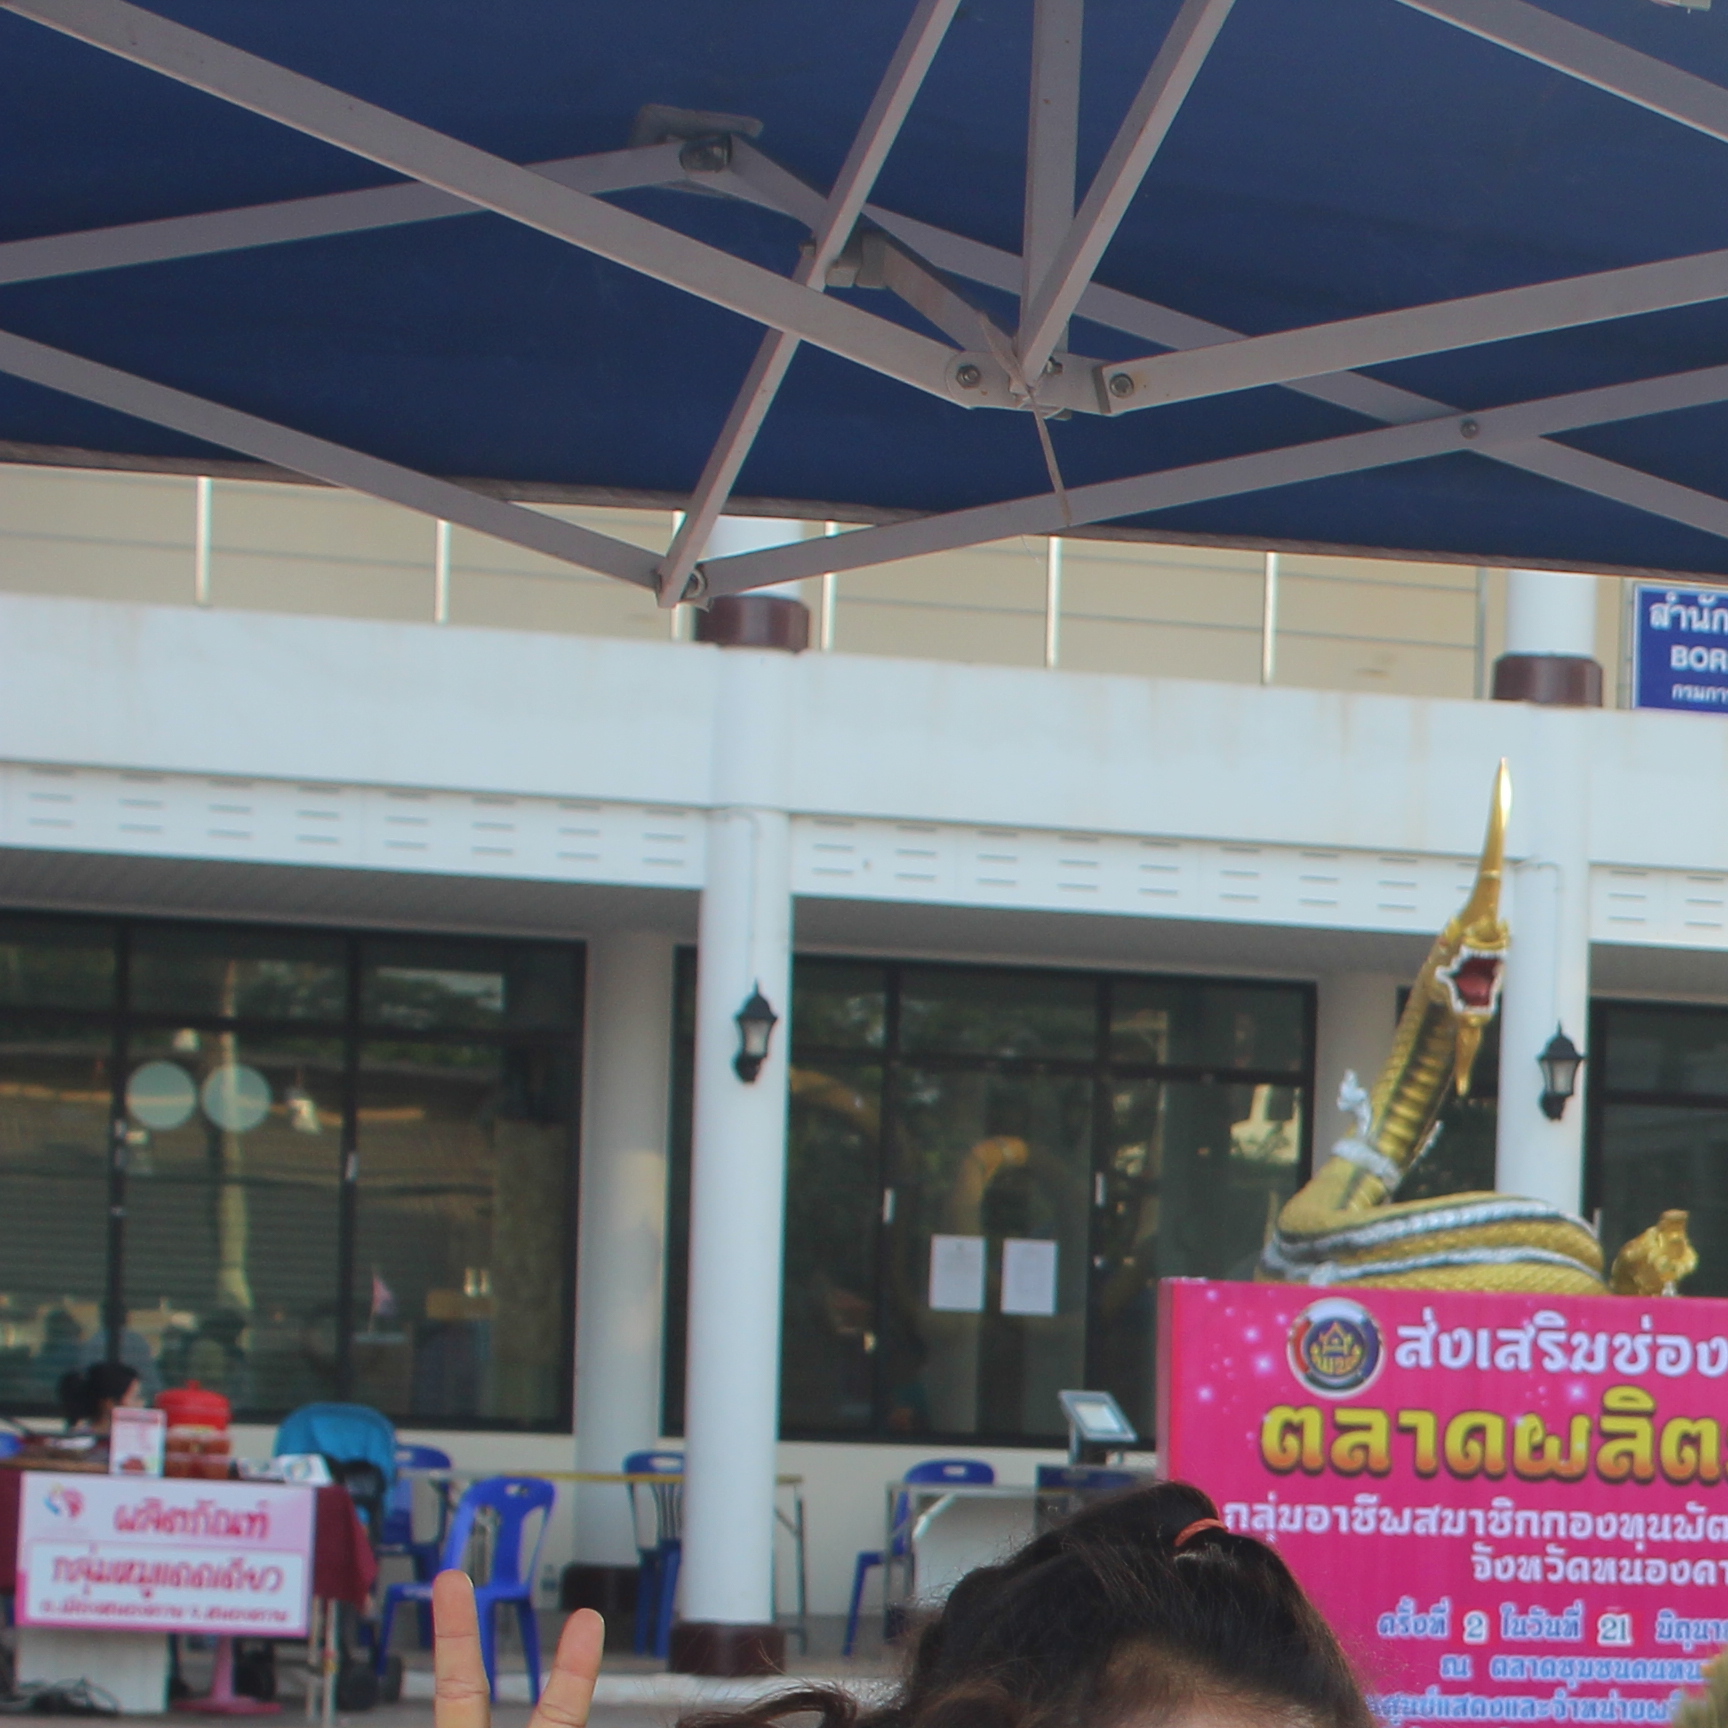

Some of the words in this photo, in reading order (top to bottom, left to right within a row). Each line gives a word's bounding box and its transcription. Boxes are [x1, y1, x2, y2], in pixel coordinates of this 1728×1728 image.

[1377, 1595, 1449, 1640] ครั้งที่
[1461, 1608, 1490, 1646] 2
[1500, 1599, 1584, 1641] ในวันที่
[1596, 1611, 1635, 1647] 21
[1440, 1653, 1473, 1679] ณ
